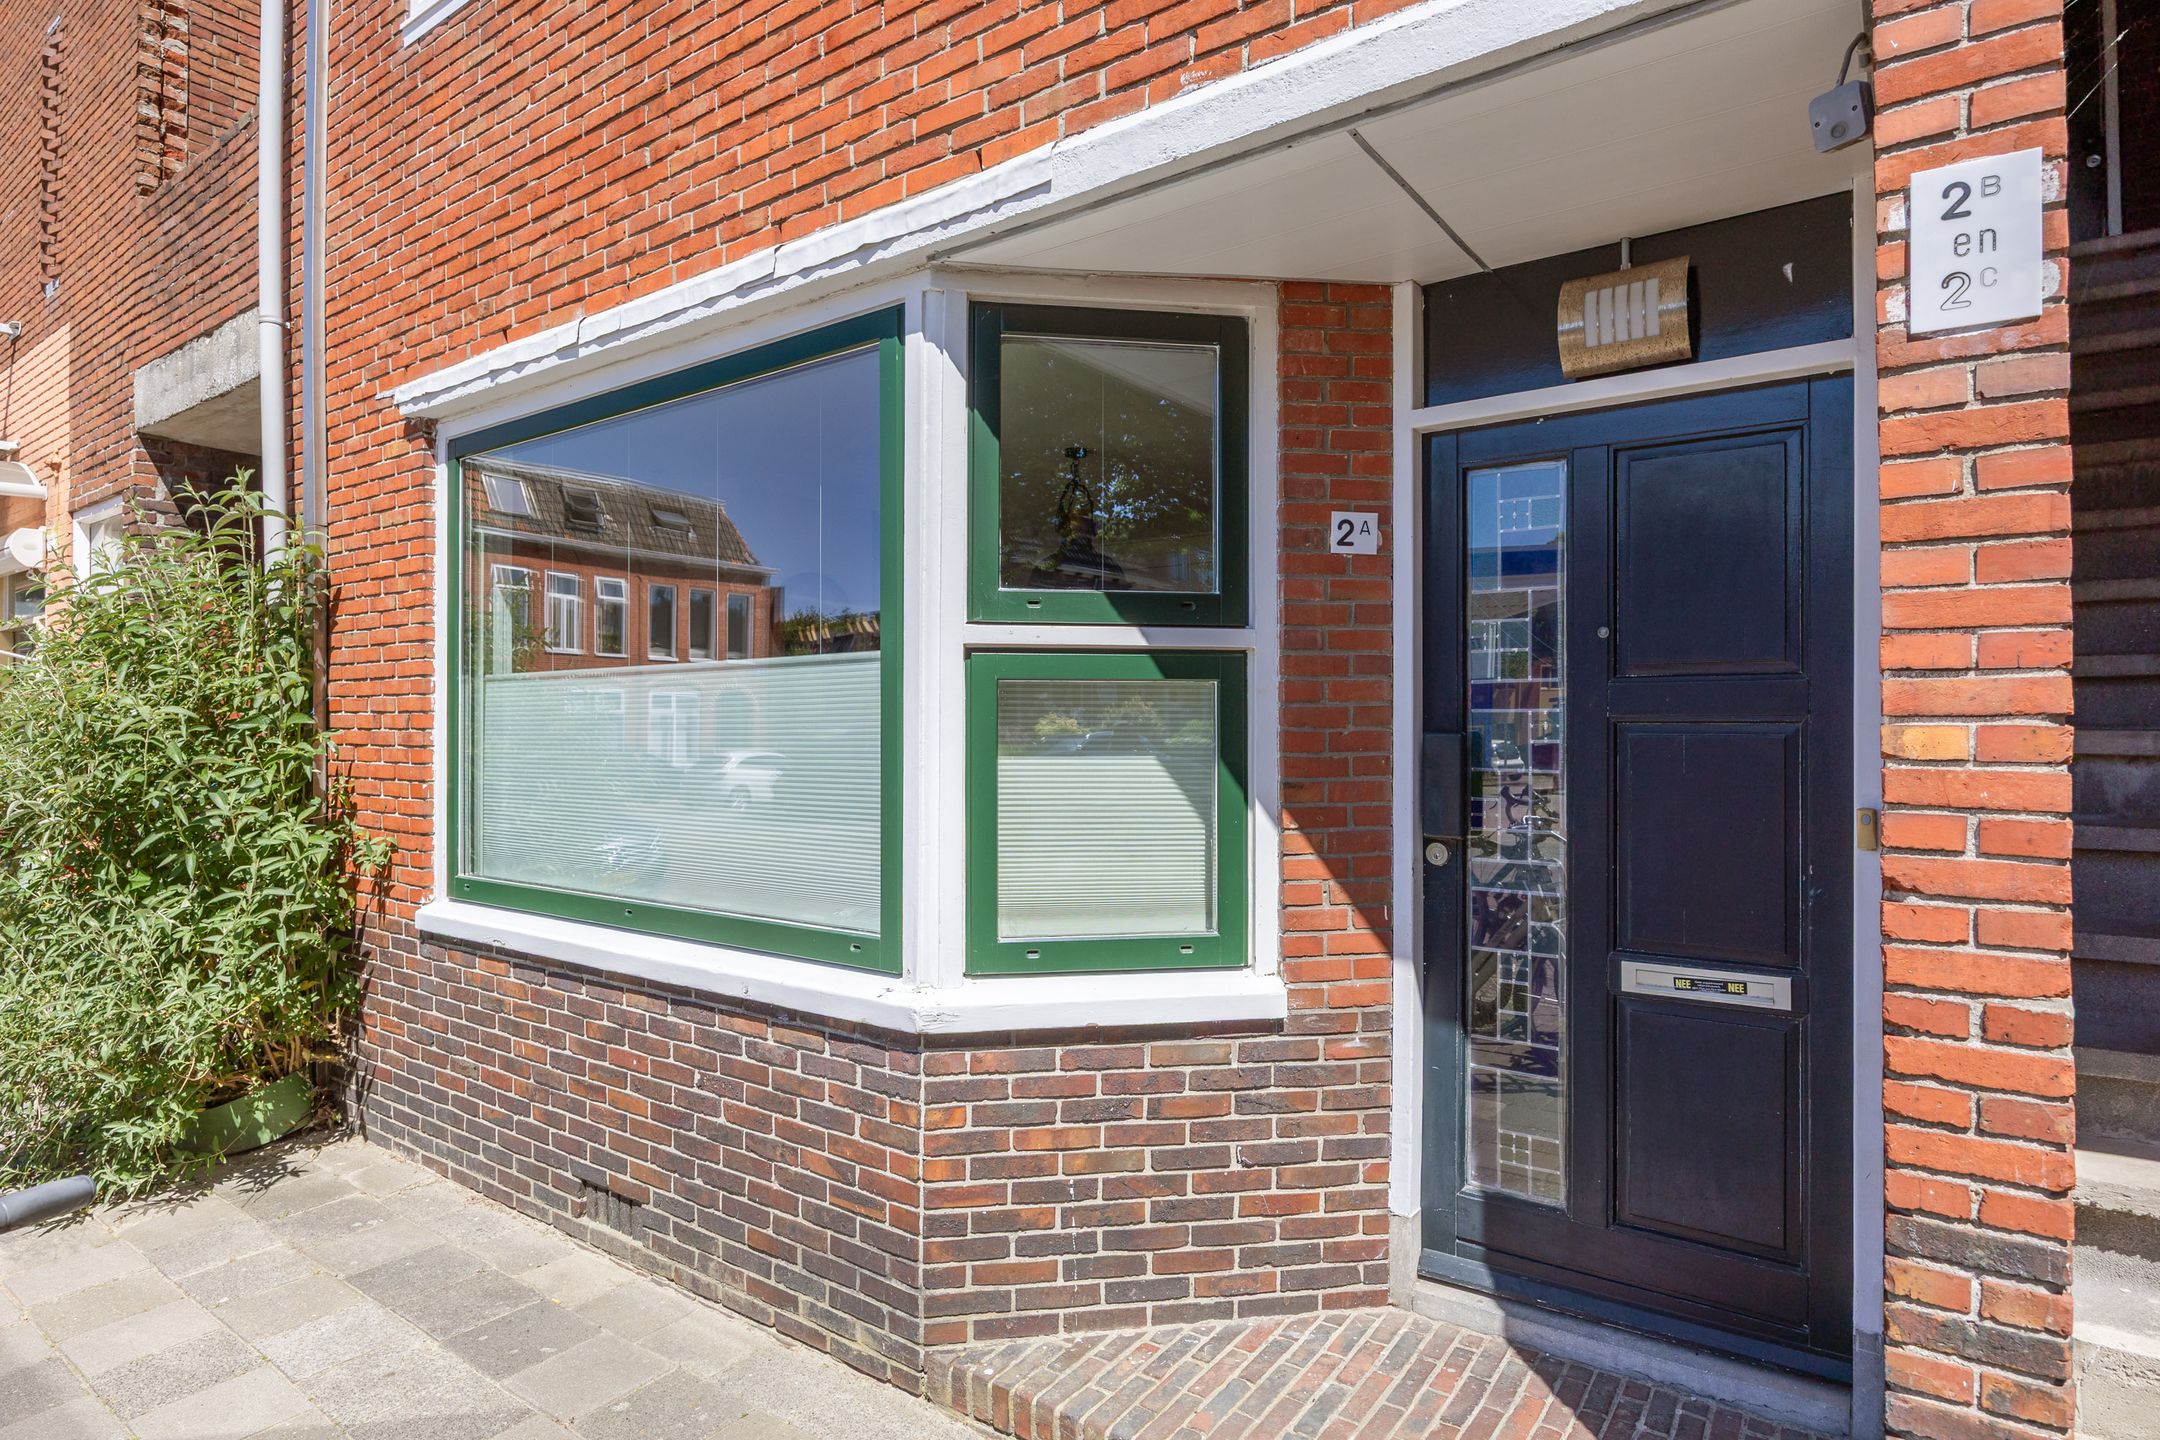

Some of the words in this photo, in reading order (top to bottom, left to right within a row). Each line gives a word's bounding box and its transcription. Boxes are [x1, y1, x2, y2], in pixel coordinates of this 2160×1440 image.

[1953, 228, 1997, 257] en
[1336, 518, 1371, 547] 2A
[1675, 979, 1691, 989] NEE
[1728, 983, 1745, 993] NEE
